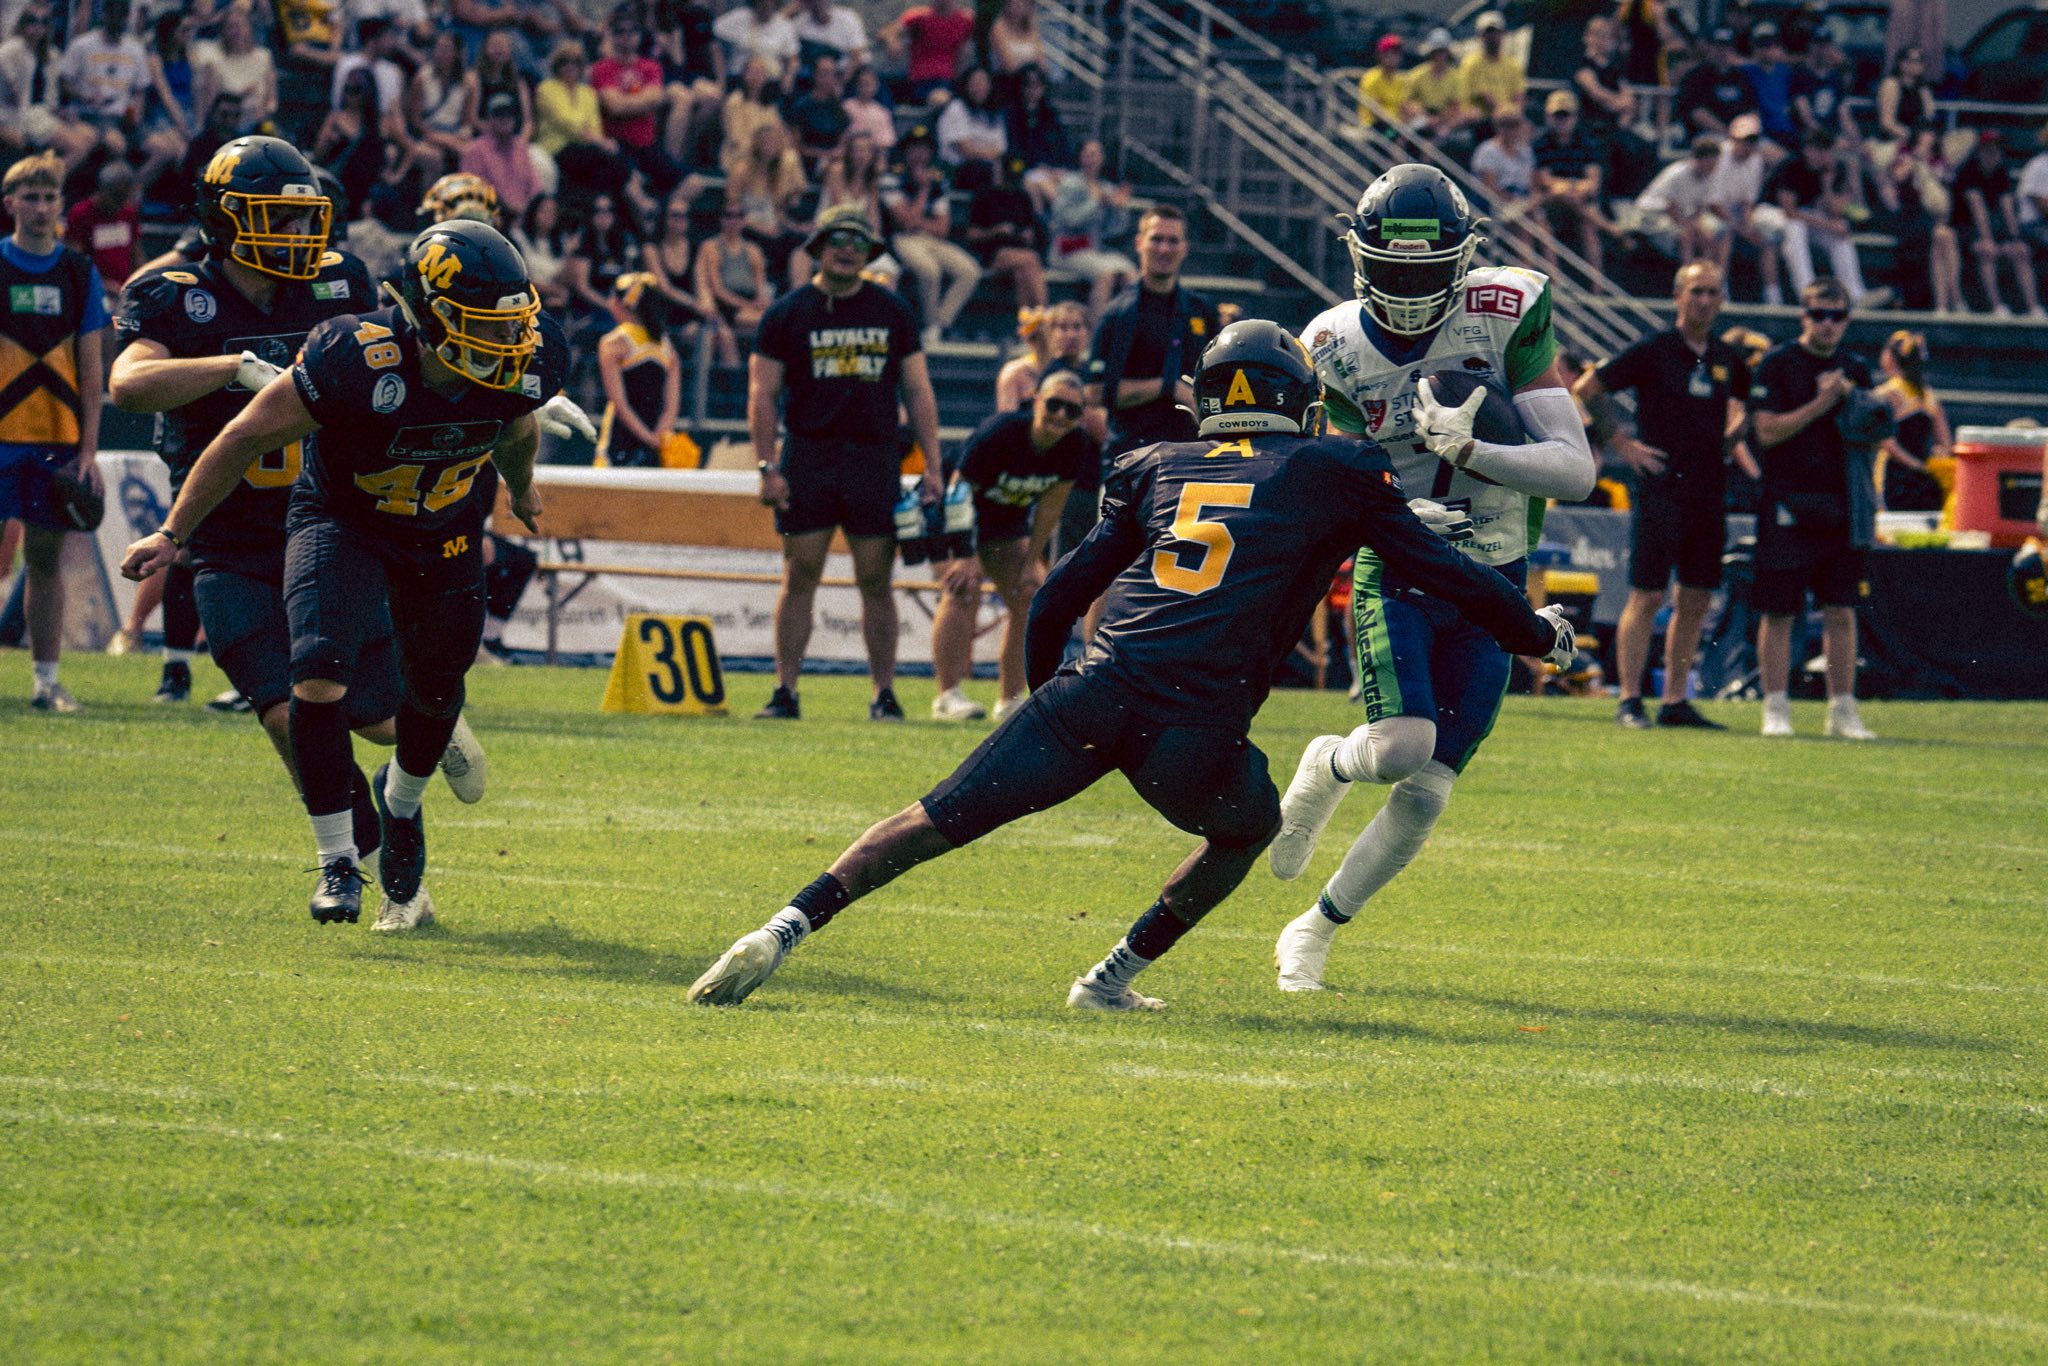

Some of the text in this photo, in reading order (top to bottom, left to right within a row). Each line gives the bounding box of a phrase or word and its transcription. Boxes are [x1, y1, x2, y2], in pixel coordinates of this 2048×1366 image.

[810, 328, 888, 348] LOYALTY
[1453, 326, 1482, 337] VFG
[813, 355, 887, 378] FAMILY
[1225, 369, 1256, 405] A
[1276, 393, 1284, 405] 5
[1219, 420, 1269, 428] COWBOYS
[353, 450, 494, 516] 48
[1151, 482, 1255, 596] 5
[639, 618, 726, 706] 30
